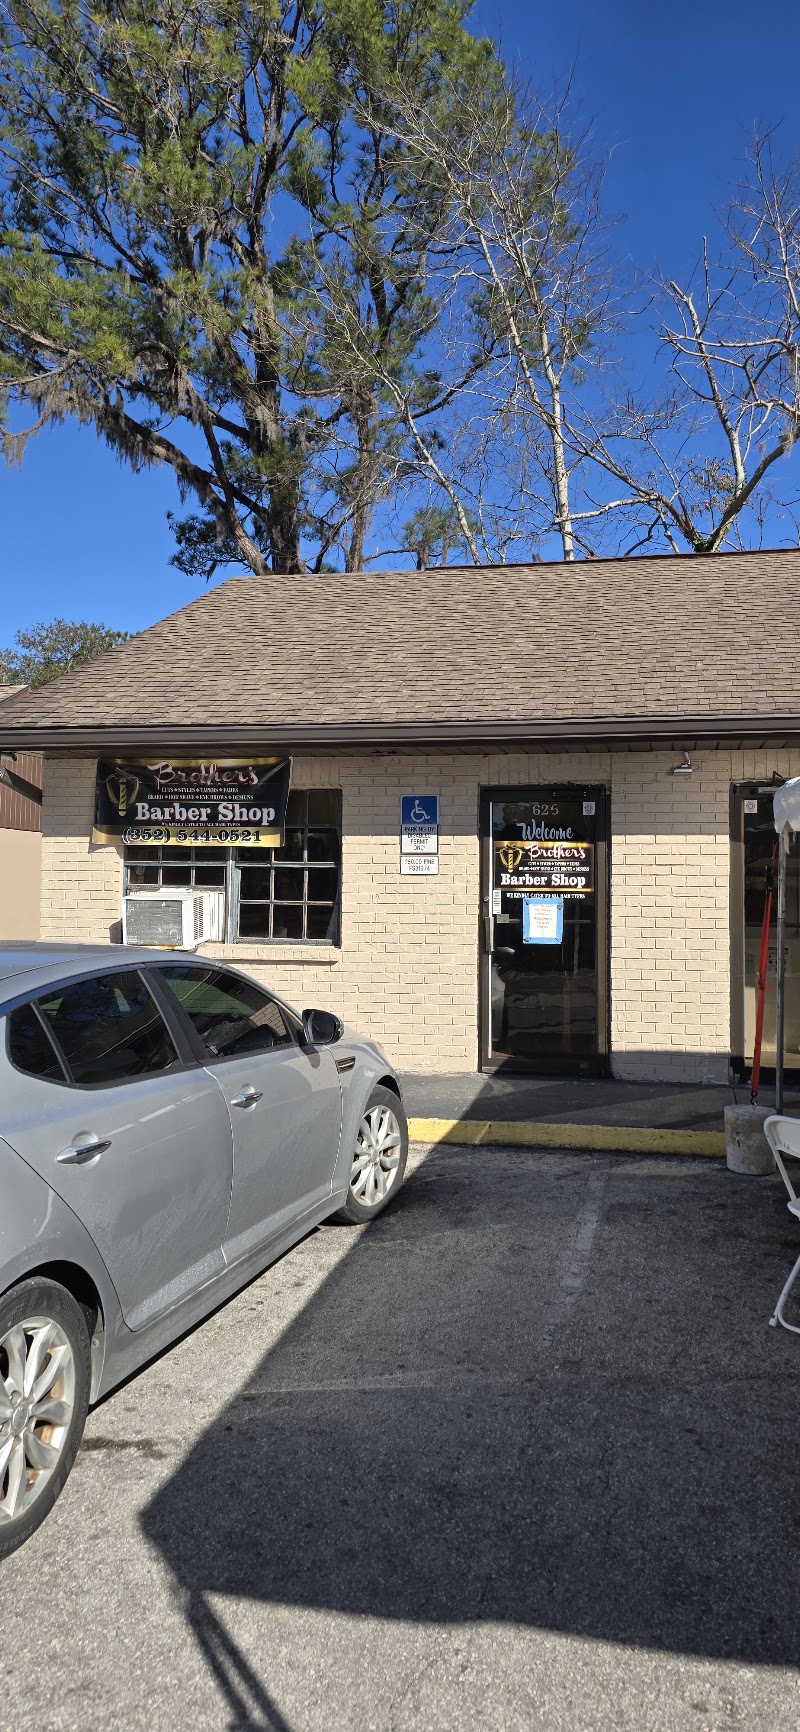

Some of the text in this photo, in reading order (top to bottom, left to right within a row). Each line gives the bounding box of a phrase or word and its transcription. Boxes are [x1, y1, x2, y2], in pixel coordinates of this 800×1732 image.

[147, 761, 259, 790] Brother's
[135, 802, 276, 826] Barber Shop
[532, 804, 559, 816] 625
[122, 827, 262, 844] (352) 544-0521
[516, 819, 574, 841] Welcome
[524, 843, 586, 861] Brother's
[500, 873, 586, 888] Barber Shop
